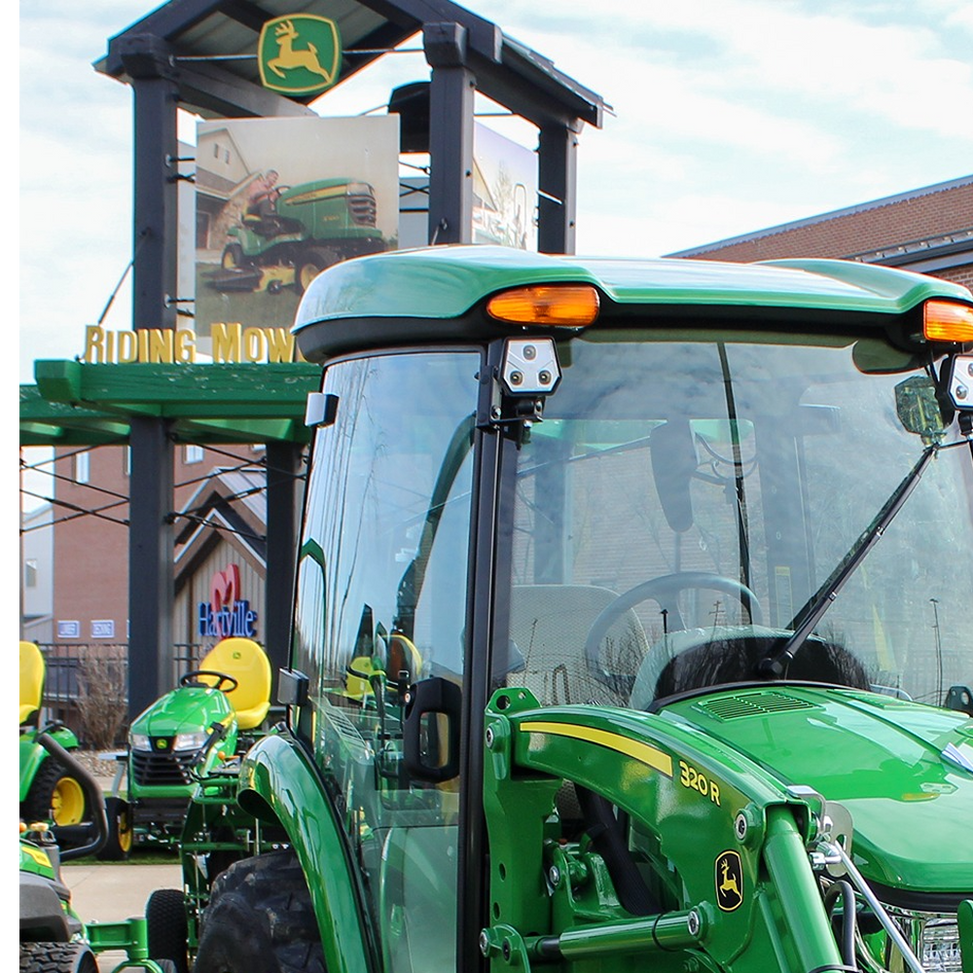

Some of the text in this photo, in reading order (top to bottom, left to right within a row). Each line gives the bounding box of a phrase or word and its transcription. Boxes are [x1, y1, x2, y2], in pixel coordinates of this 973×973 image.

[84, 322, 302, 363] RIDING MOW
[198, 601, 256, 637] Hartville
[679, 760, 721, 807] 320 R
